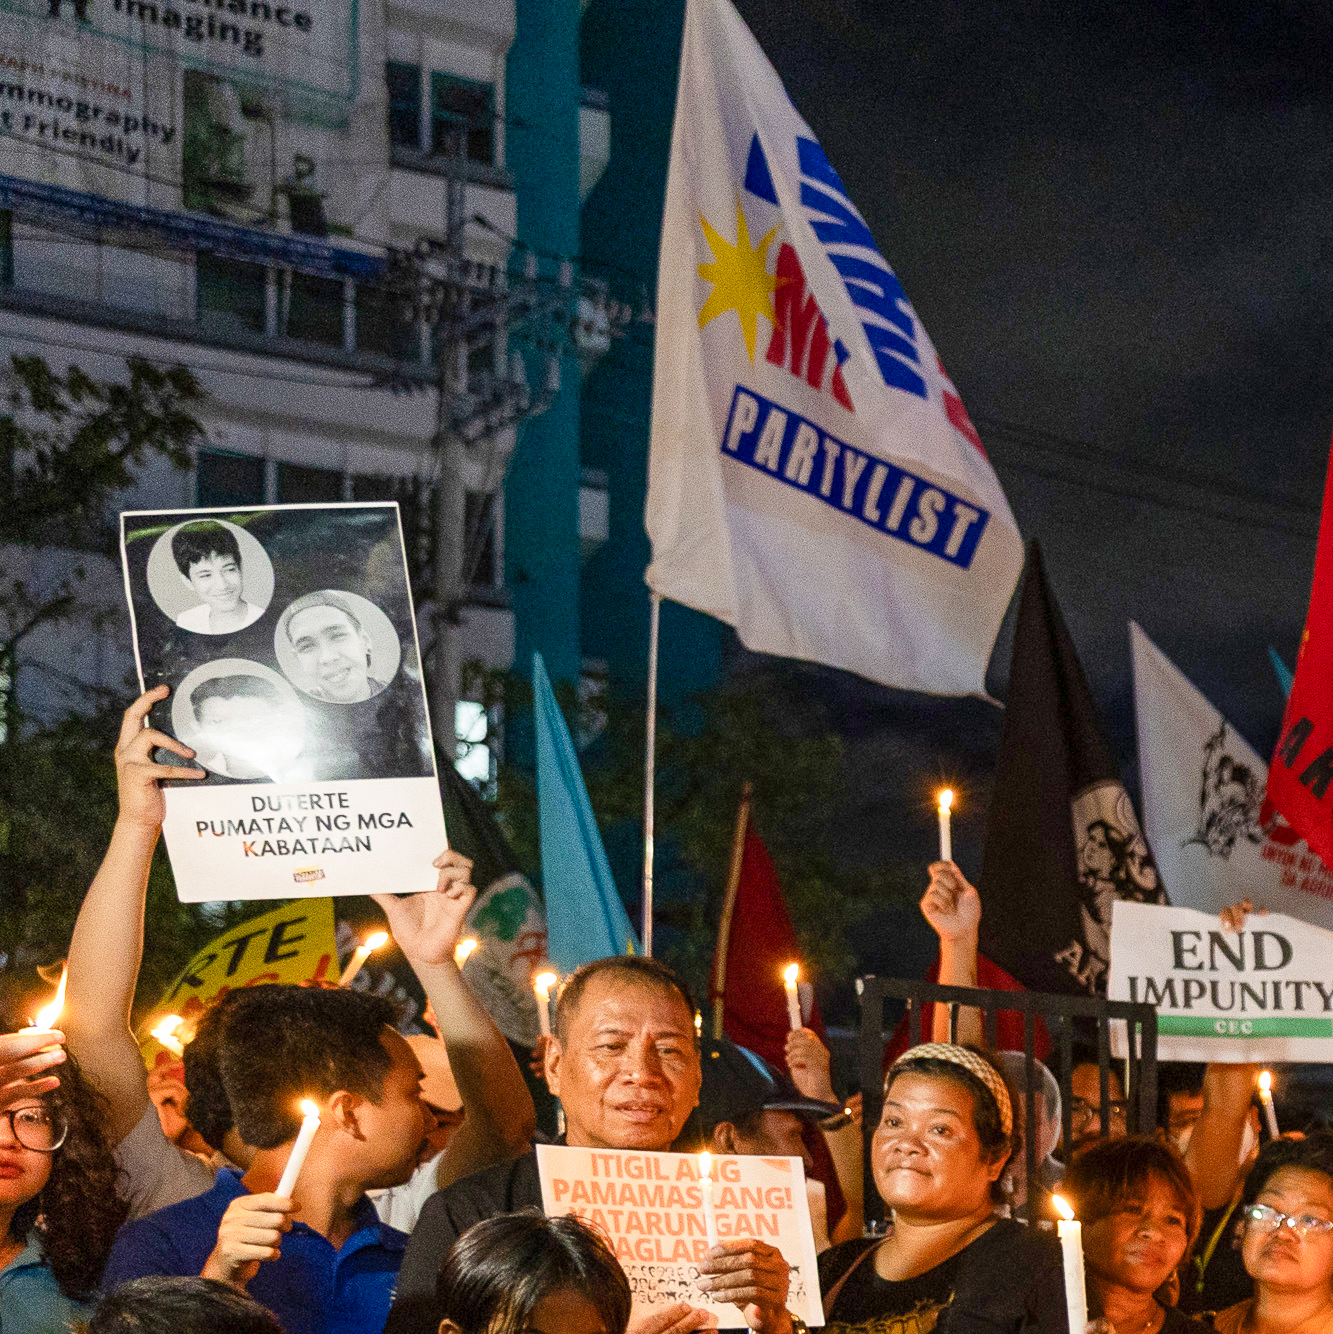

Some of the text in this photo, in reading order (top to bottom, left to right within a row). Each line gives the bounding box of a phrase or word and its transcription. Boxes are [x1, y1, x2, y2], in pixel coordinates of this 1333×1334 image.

[726, 391, 983, 560] PARTYLIST
[250, 791, 350, 813] DUTERTE
[195, 811, 414, 838] PUMATAY NG MGA
[242, 835, 373, 858] KABATAAN
[1170, 929, 1295, 973] END
[590, 1152, 670, 1182] ITIGIL
[552, 1178, 794, 1211] PAMAMASANG!
